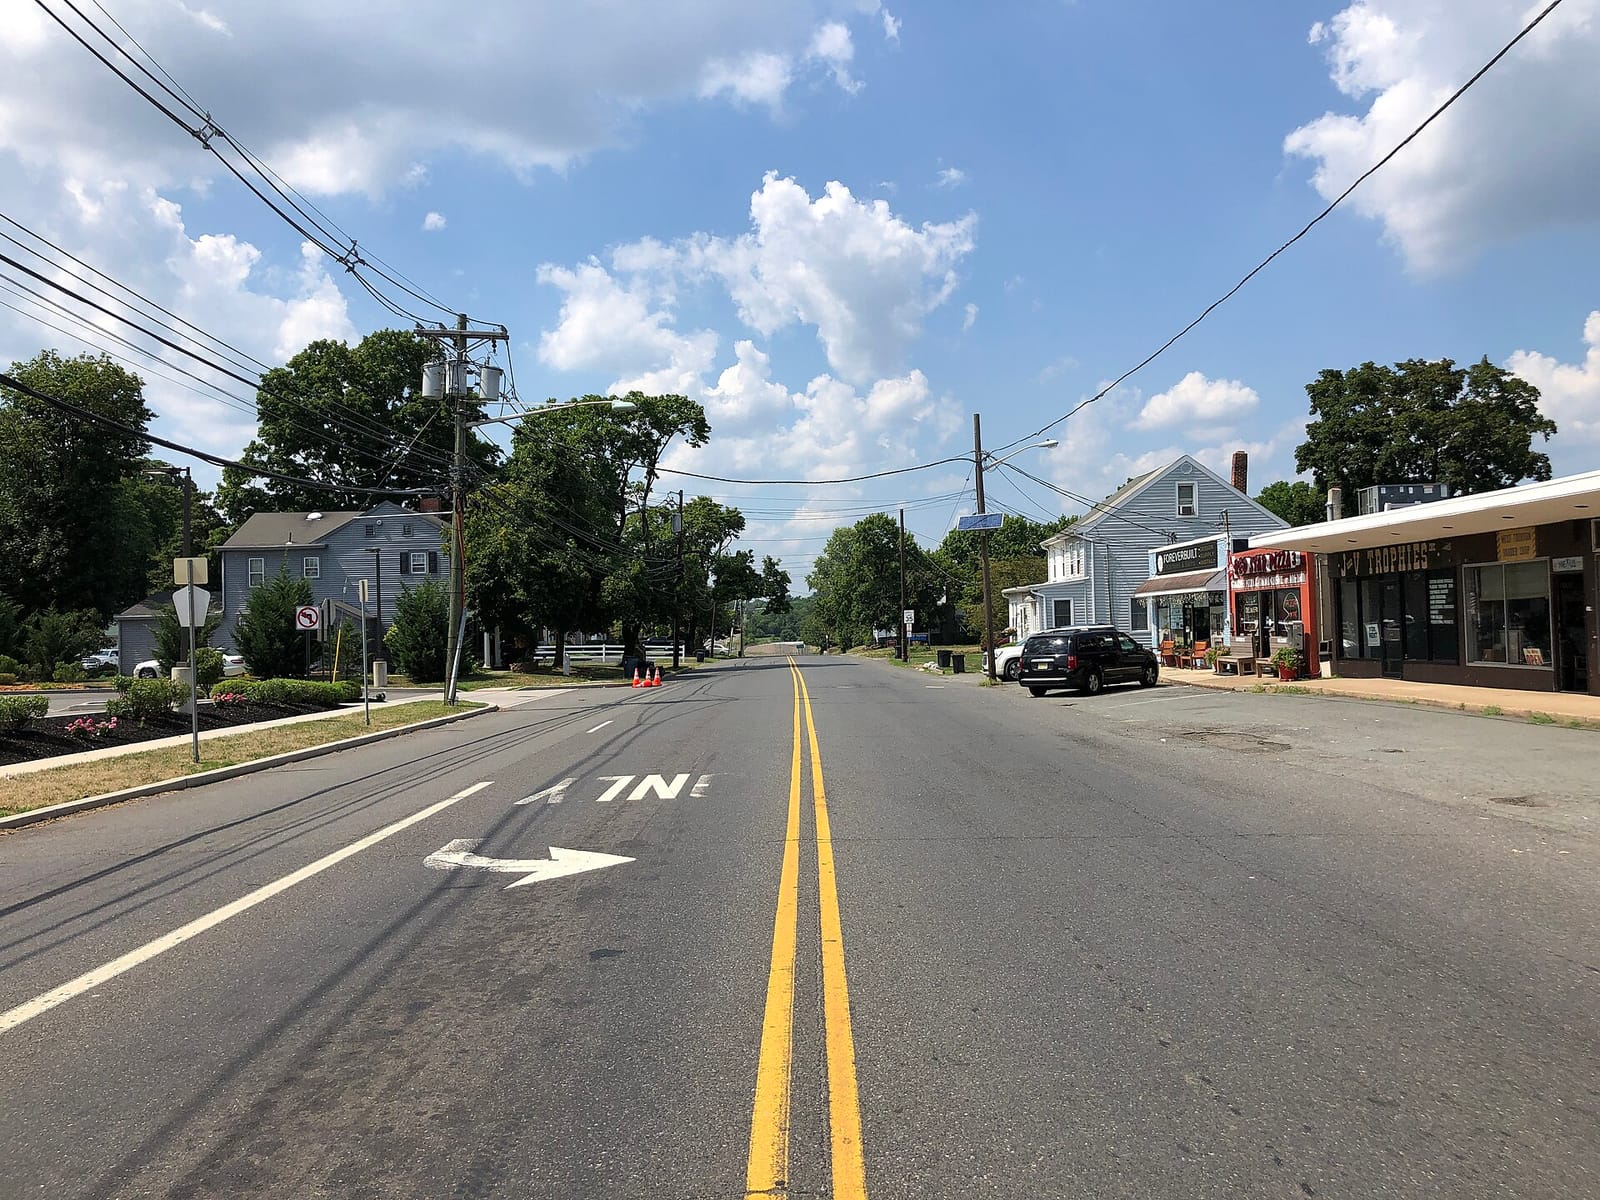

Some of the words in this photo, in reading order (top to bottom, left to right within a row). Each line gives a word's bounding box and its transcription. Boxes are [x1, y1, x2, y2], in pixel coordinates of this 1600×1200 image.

[1163, 548, 1198, 564] FOREVERBUILT
[1367, 542, 1428, 575] TROPHIES
[1526, 654, 1543, 666] OPEN
